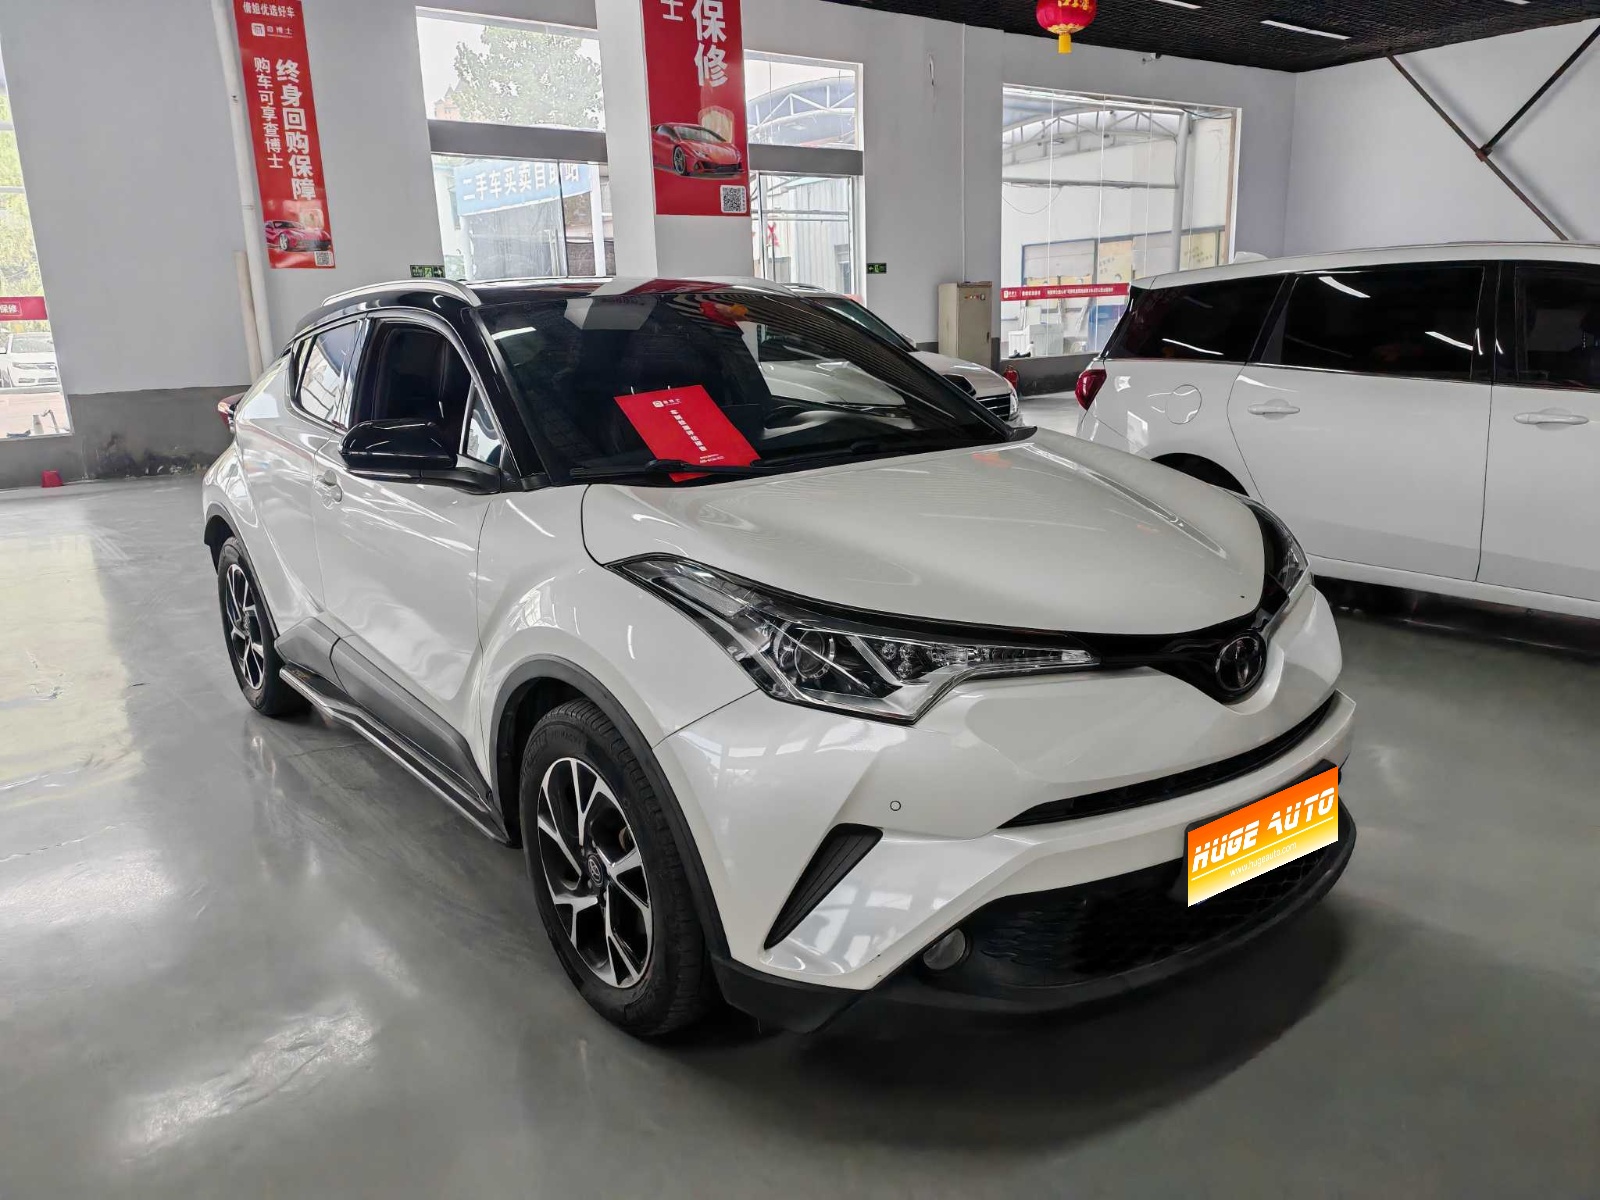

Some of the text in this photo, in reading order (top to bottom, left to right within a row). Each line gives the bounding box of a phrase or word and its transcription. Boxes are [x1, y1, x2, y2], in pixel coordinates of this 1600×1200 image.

[691, 0, 728, 88] 保修
[254, 57, 283, 169] 购车可享查博士
[275, 58, 316, 200] 终身回购保障
